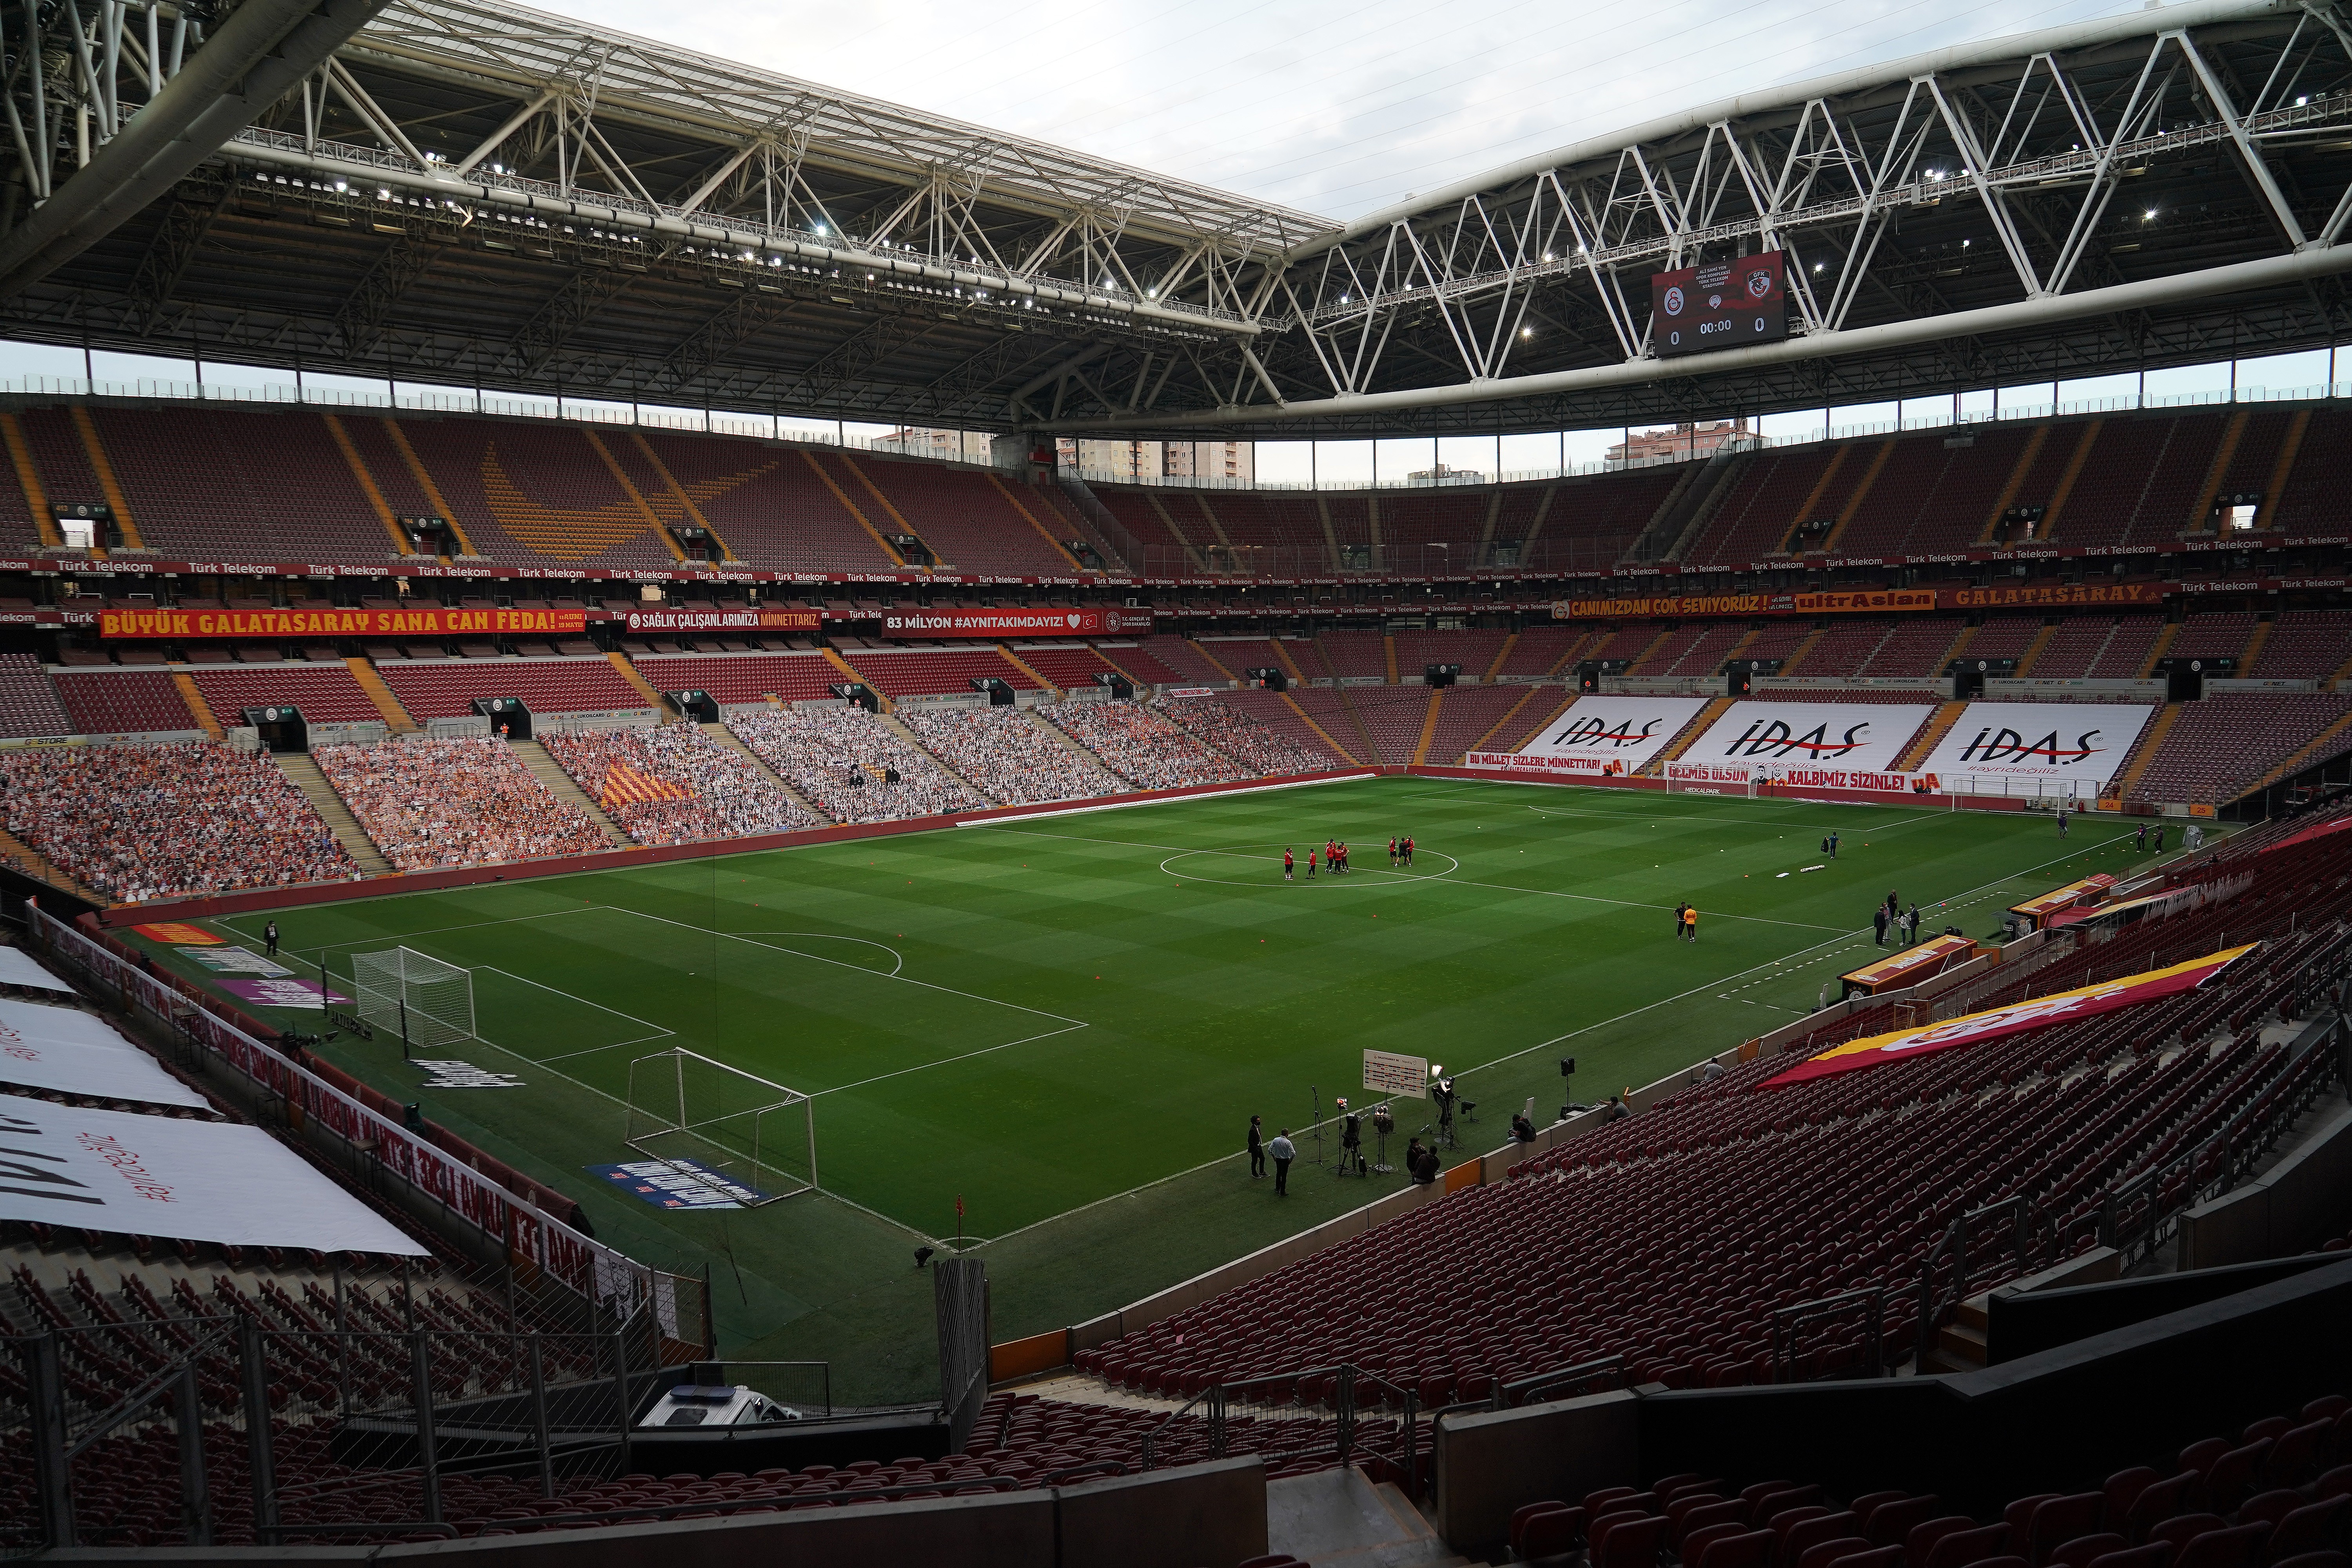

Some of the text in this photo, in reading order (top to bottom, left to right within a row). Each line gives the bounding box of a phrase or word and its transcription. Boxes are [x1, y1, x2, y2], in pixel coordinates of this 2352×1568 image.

[1707, 269, 1731, 279] KOMPLEKSİ
[1700, 319, 1731, 334] 00:00
[1755, 317, 1764, 332] 0
[1671, 331, 1679, 345] 0
[2185, 540, 2263, 551] Türk Telekom
[2307, 536, 2348, 544] Telekom
[1992, 550, 2058, 560] Türk Telekom
[2085, 545, 2156, 556] Türk Telekom
[1825, 558, 1882, 567] Türk Telekom
[1906, 553, 1967, 564] Türk Telekom
[57, 560, 153, 572] Türk Telekom
[189, 563, 276, 574] Türk Telekom
[308, 564, 388, 576] Türk Telekom
[1698, 564, 1730, 573] Telekom
[1750, 561, 1804, 570] Türk Telekom
[417, 566, 491, 577] Türk Telekom
[518, 568, 585, 578] Türk Telekom
[610, 569, 672, 579] Türk Telekom
[695, 571, 753, 581] Türk Telekom
[774, 572, 828, 582] Türk Telekom
[847, 573, 897, 582] Türk Telekom
[2181, 582, 2258, 592] Türk Telekom
[2281, 579, 2345, 588] Türk Telekom
[1799, 593, 1930, 608] ultrAslan
[1956, 585, 2143, 605] GALATASARAY
[1572, 599, 1649, 617] CANIMIZDAN
[1653, 598, 1678, 615] ÇOK
[62, 612, 94, 622] Türk
[868, 610, 882, 619] Tele
[103, 610, 555, 635] BÜYÜK GALATASARAY SANA CAN FEDA!
[642, 612, 819, 630] SAĞLIK ÇALIŞANLARIMIZA MİNNETTARIZ.
[887, 614, 1063, 628] 83 MİLYON #AYNITAKIMDAYIZ!
[1470, 753, 1601, 769] BU MİLLET SİZLERE MİNNETTAR!
[1788, 769, 1904, 790] KALBİMİZ SİZİNLE!
